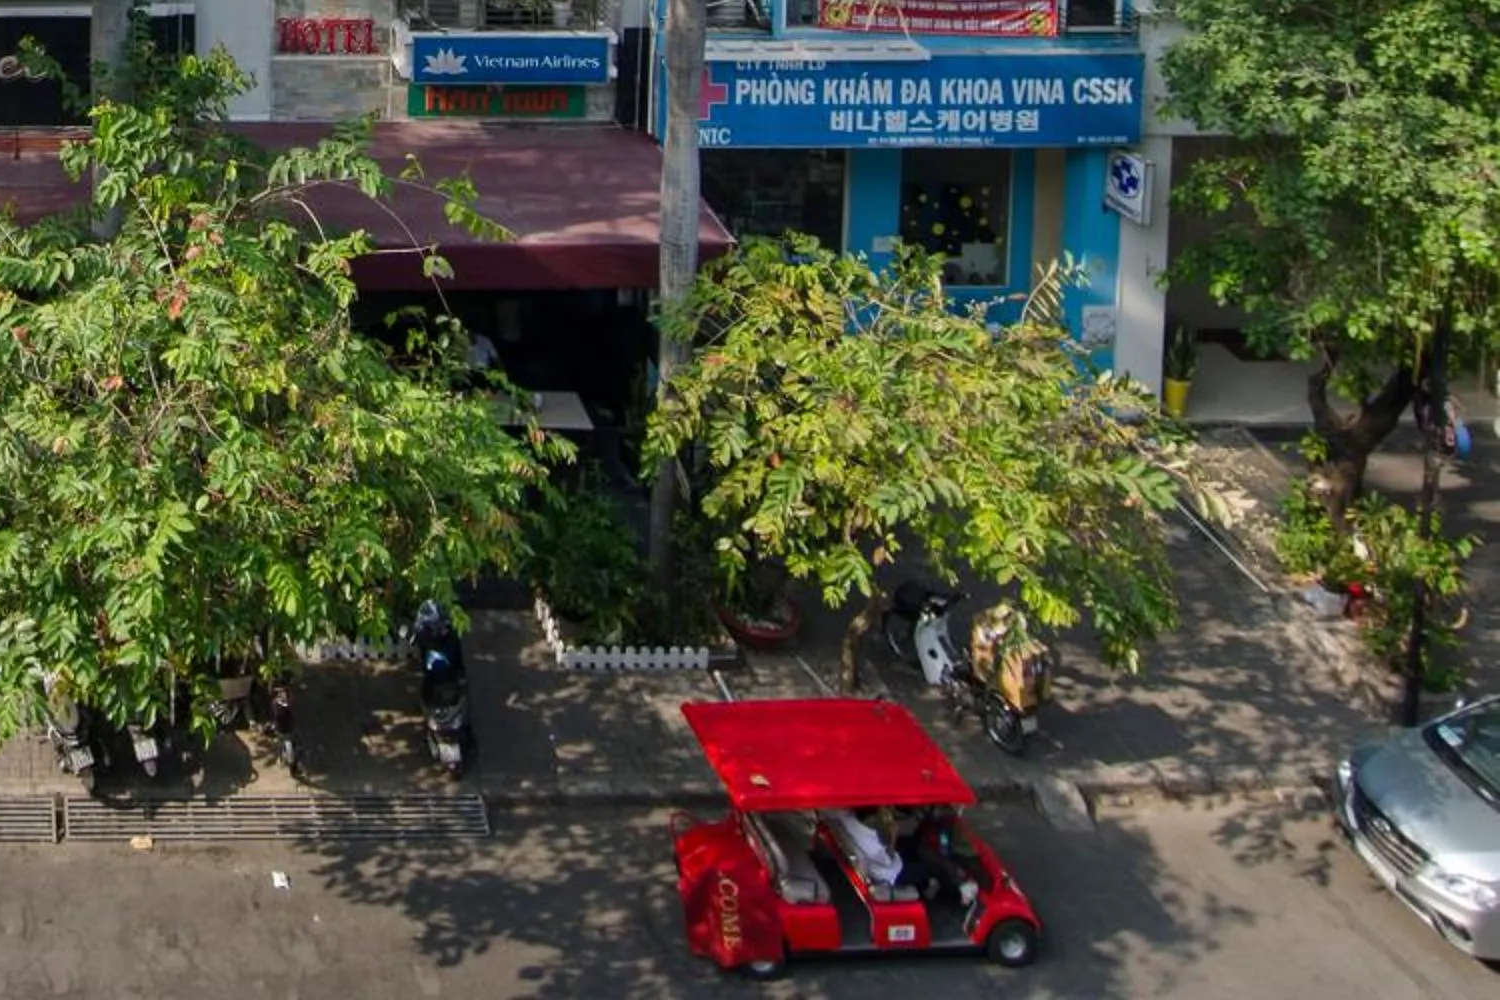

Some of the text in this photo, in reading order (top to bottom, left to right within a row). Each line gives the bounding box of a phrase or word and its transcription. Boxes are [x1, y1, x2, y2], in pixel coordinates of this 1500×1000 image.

[276, 17, 375, 55] HOTEL
[474, 53, 601, 69] Vietnam Airlines
[735, 70, 1135, 106] PHÒNG KHÁM ĐA KHOA VINA CSSK
